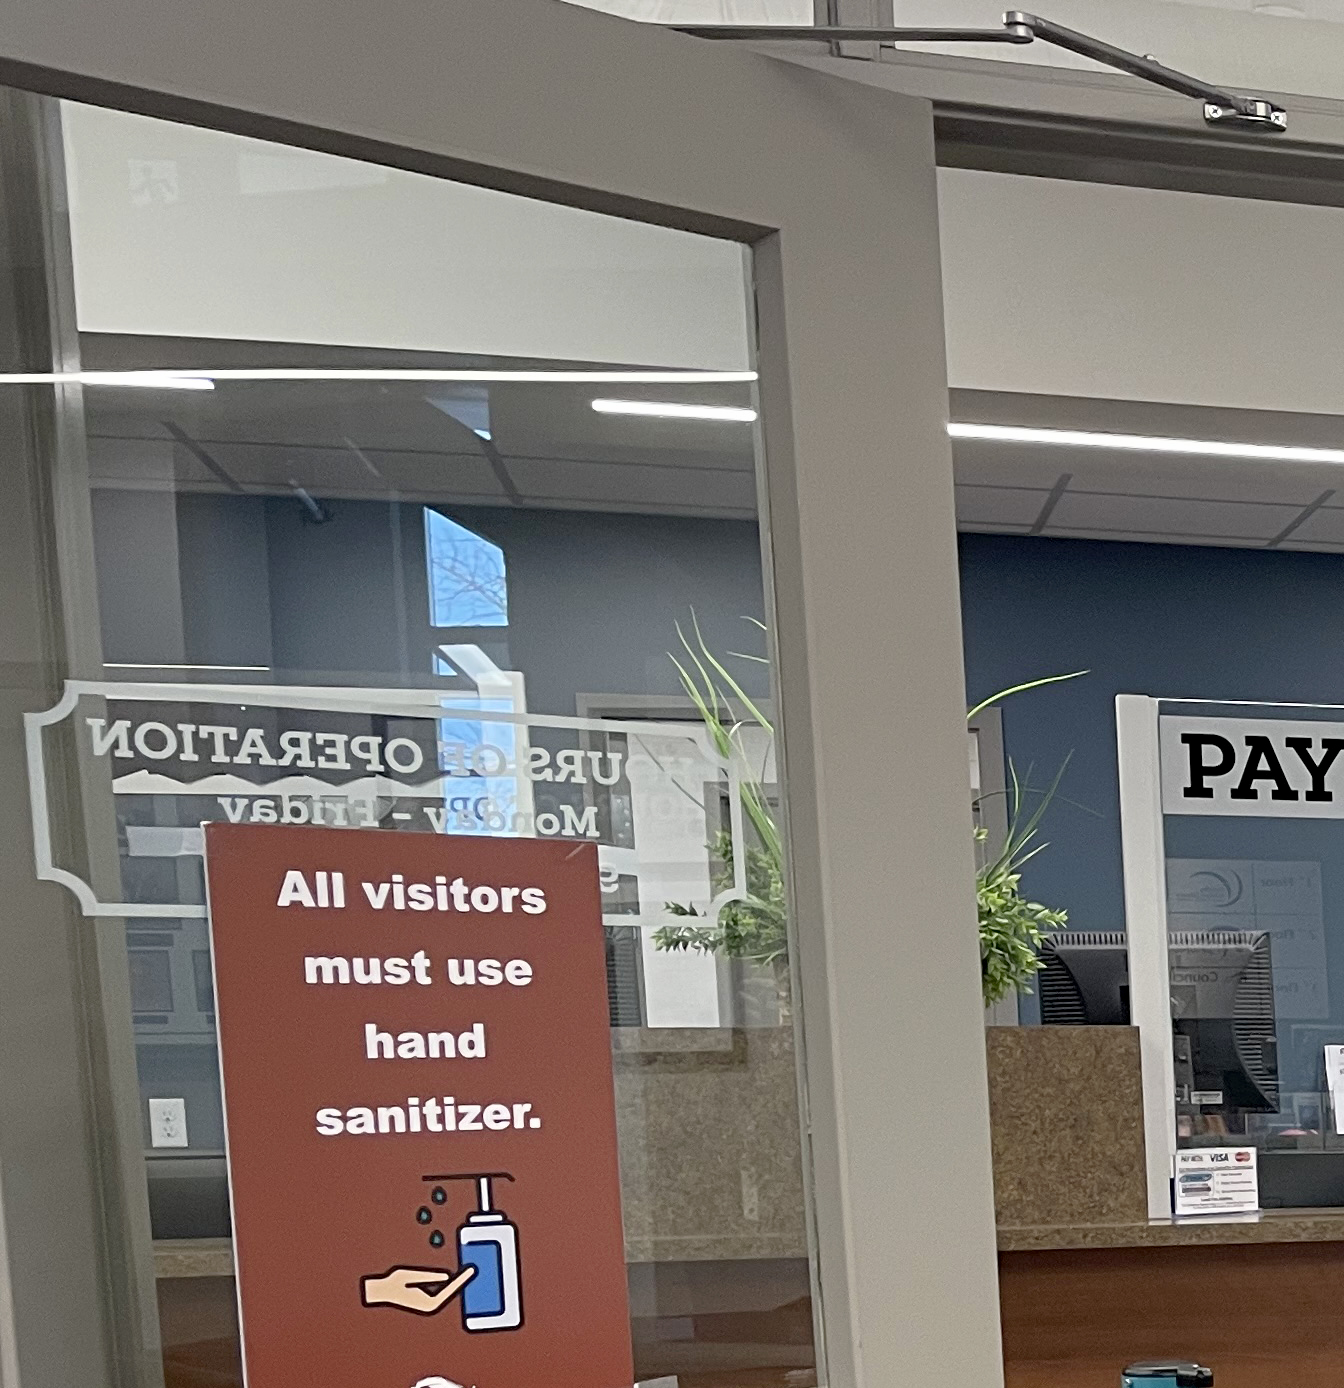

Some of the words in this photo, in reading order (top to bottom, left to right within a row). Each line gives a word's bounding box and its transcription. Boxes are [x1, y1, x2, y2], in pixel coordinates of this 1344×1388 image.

[277, 869, 346, 909] All
[362, 874, 548, 915] visitors
[304, 950, 431, 986] must
[448, 955, 533, 987] use
[364, 1023, 486, 1060] hand
[315, 1096, 542, 1136] sanitizer.
[1209, 1153, 1229, 1162] VISA
